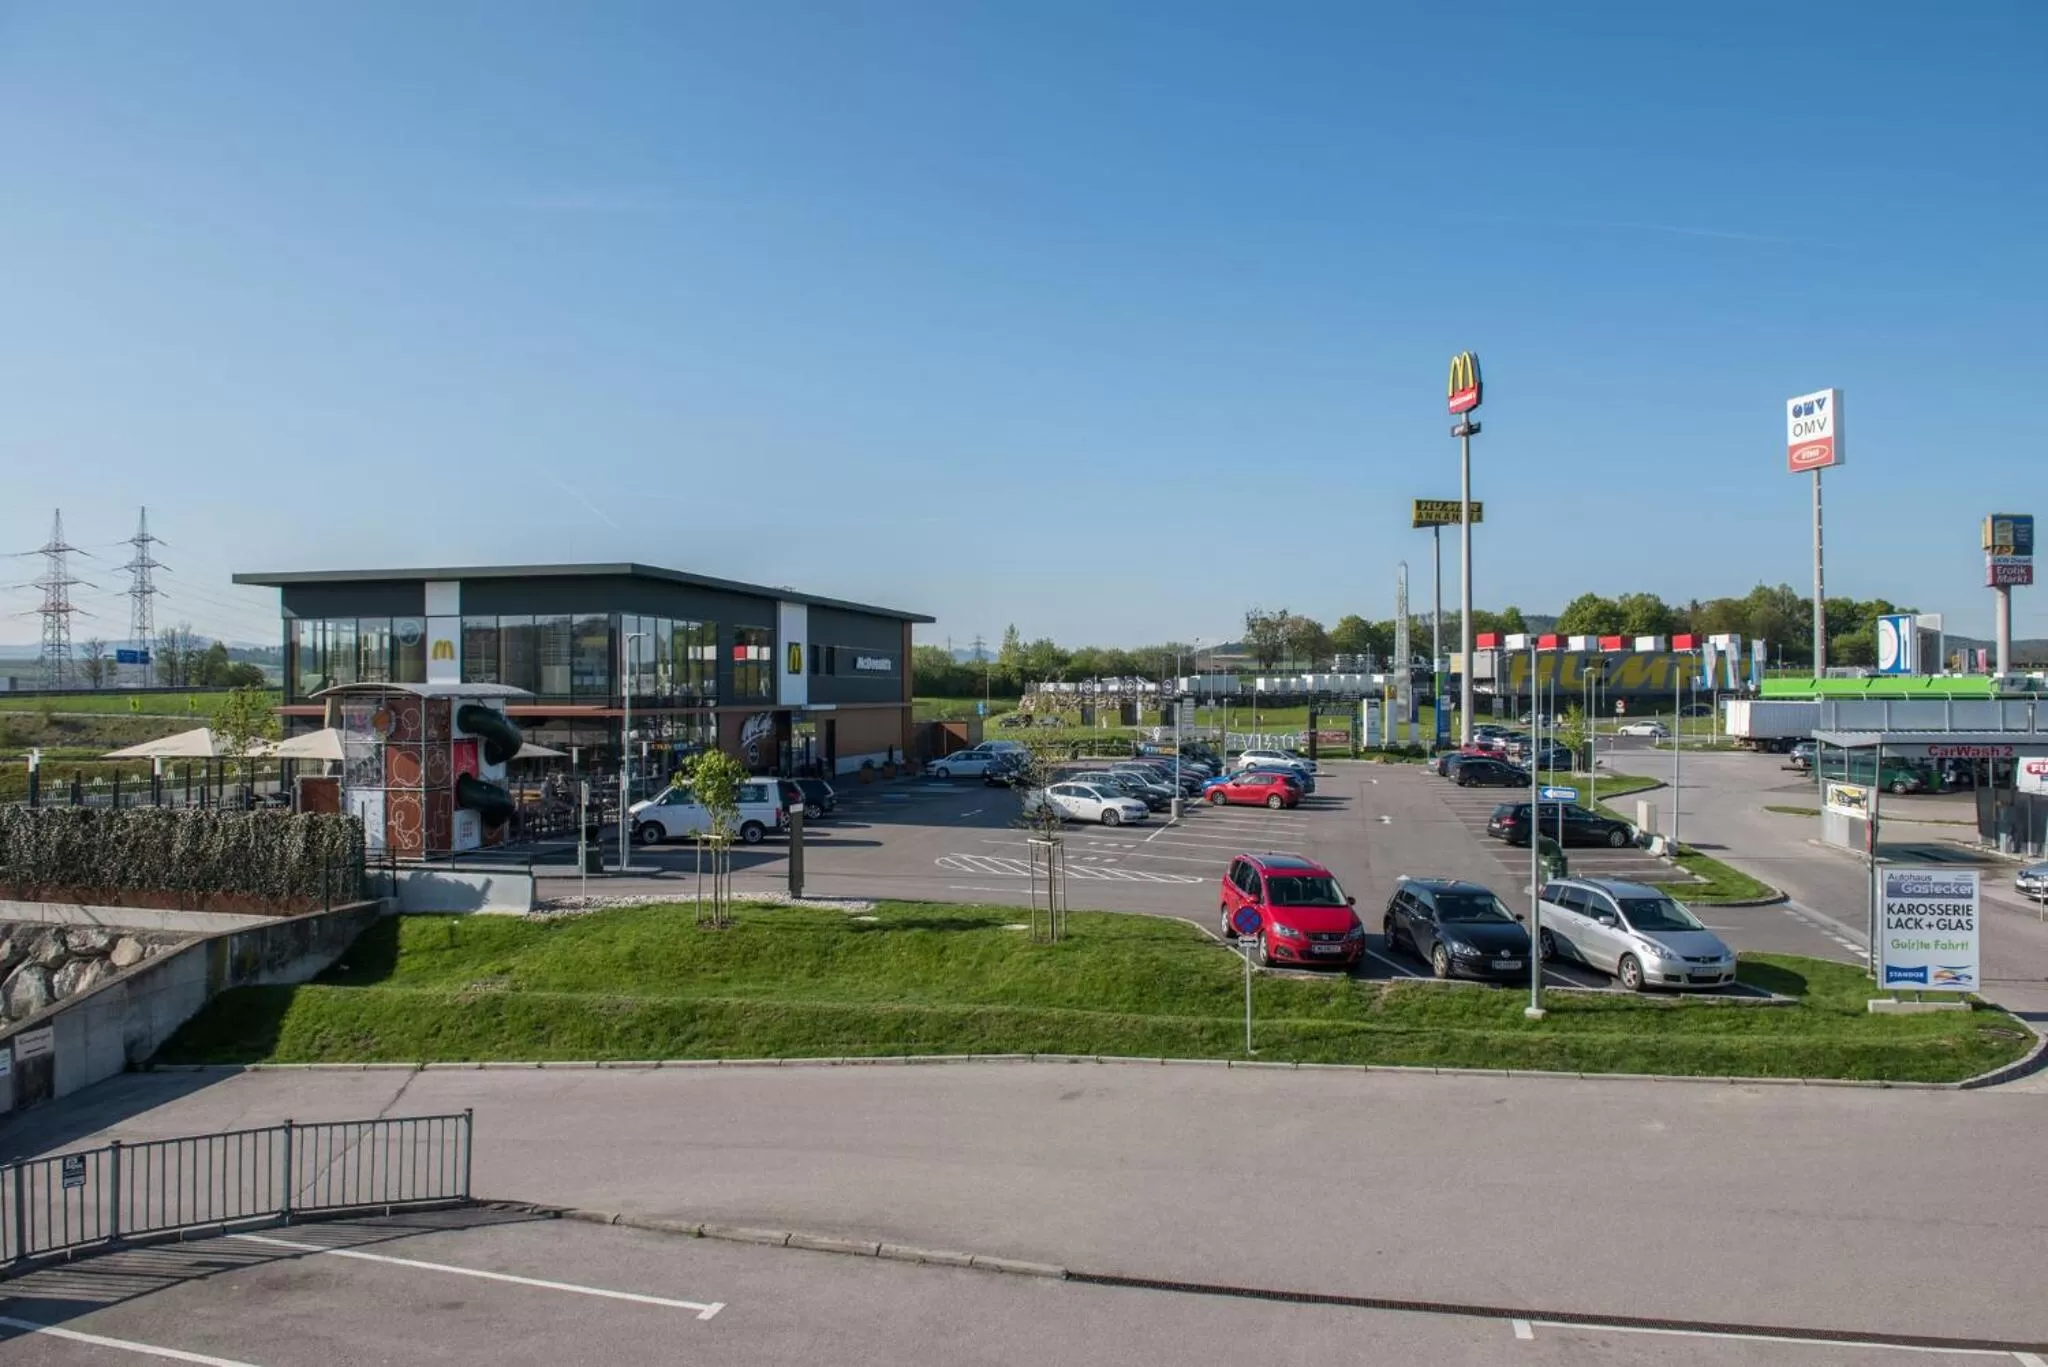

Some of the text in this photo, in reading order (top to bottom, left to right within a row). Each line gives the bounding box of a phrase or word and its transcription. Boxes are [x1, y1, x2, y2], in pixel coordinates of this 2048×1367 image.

[1793, 417, 1827, 437] OMV
[1997, 566, 2028, 575] Erotik
[1928, 745, 2014, 757] CarWash 2
[1888, 873, 1933, 882] Autohaus
[1901, 882, 1973, 894] Gastecker
[1887, 903, 1974, 917] KAROSSERIE
[1887, 918, 1923, 930] LACK
[1936, 918, 1974, 931] GLAS
[1934, 939, 1969, 951] Fahrt!
